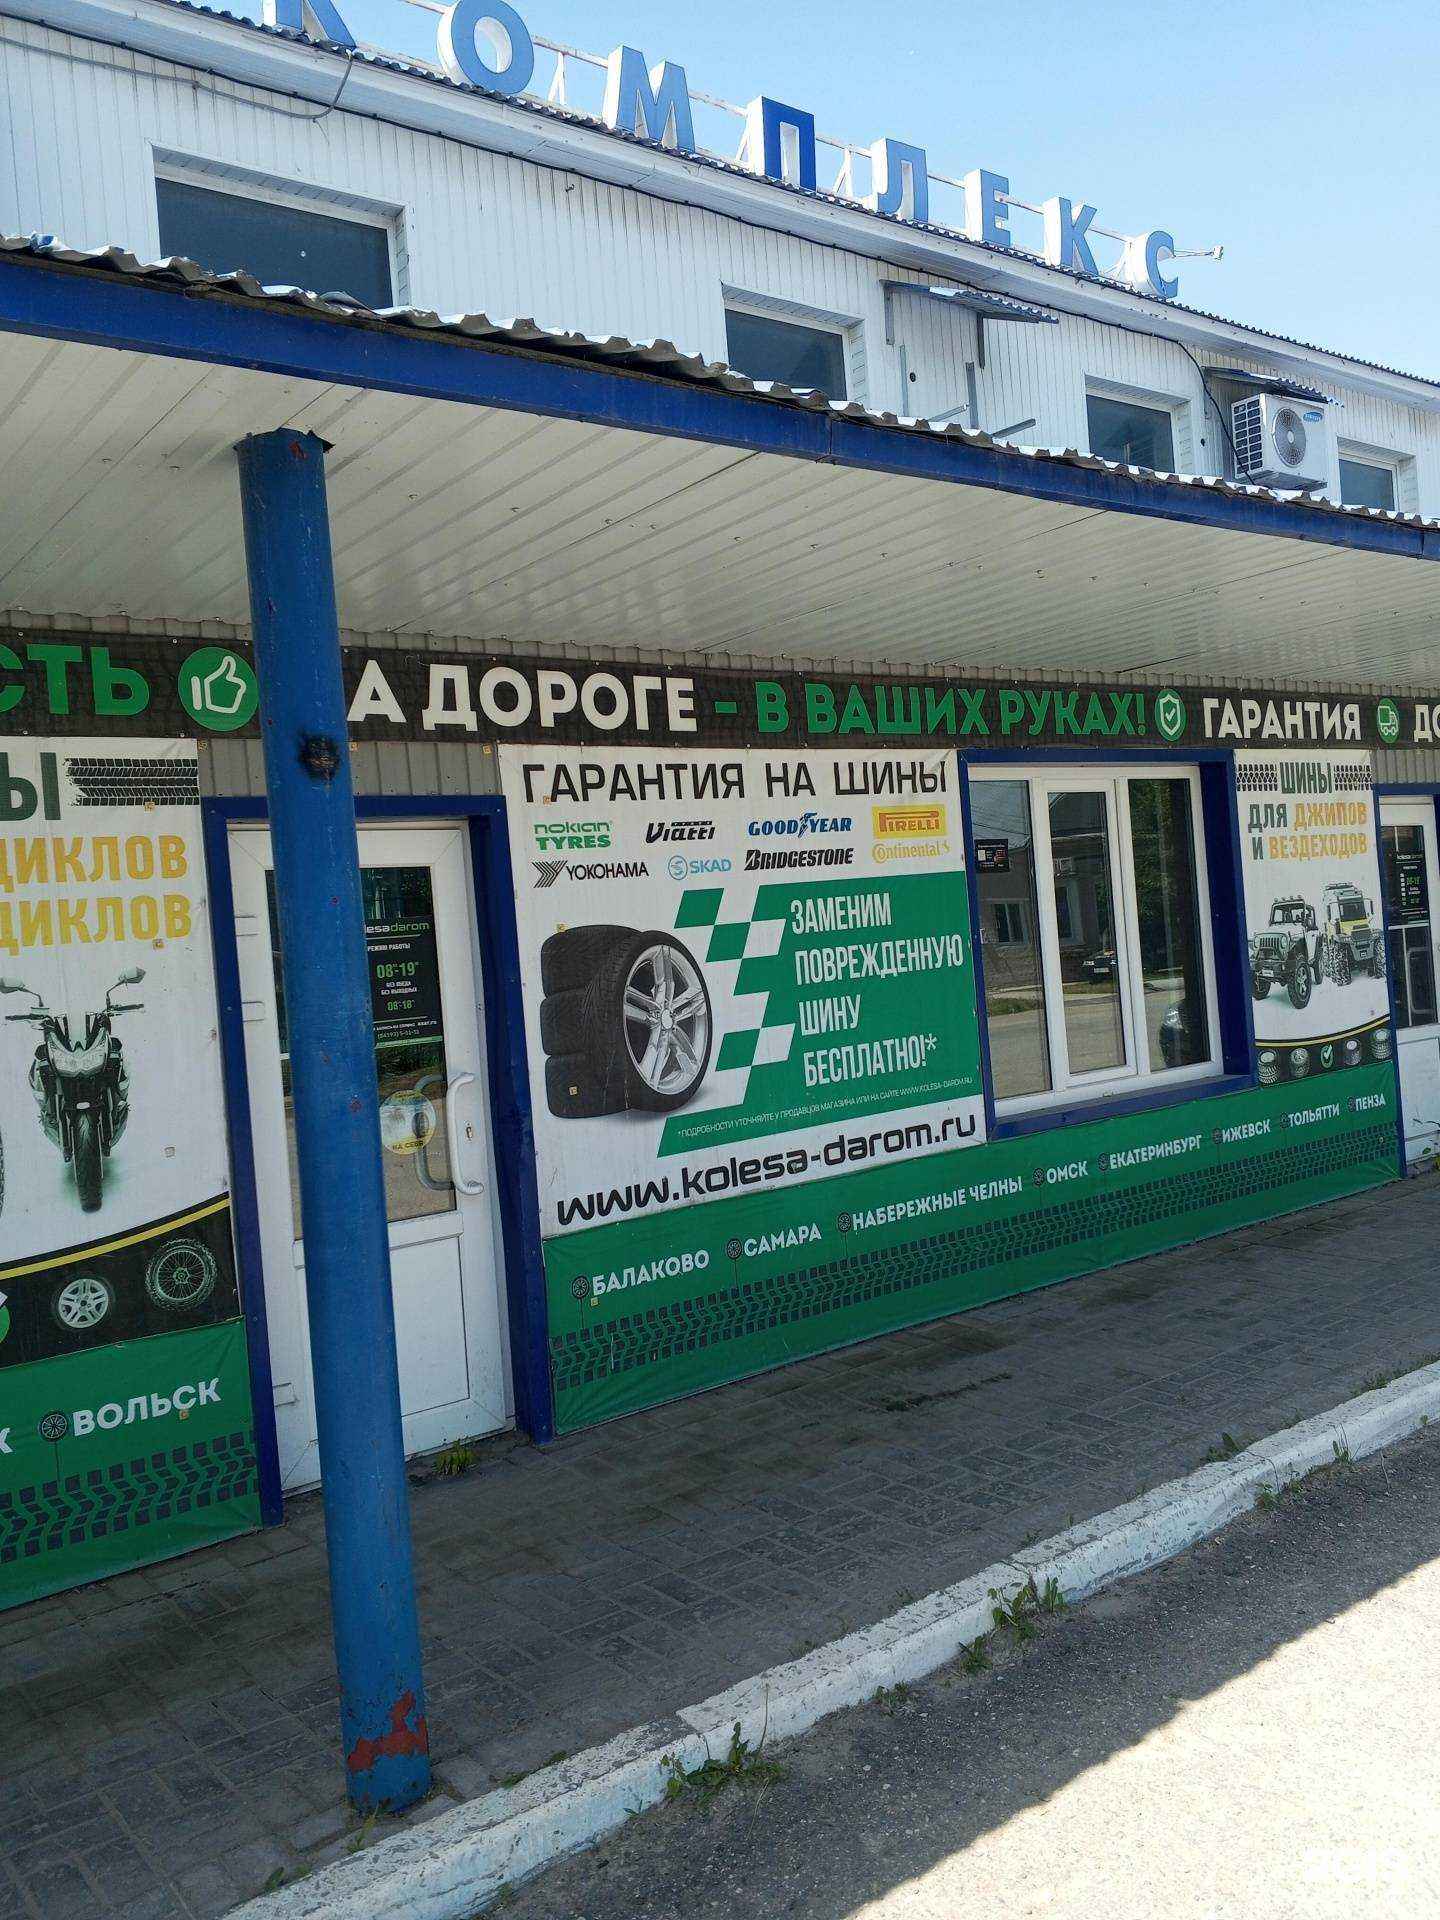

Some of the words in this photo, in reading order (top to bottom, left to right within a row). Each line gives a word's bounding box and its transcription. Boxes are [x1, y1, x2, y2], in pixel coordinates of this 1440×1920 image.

[422, 664, 698, 733] ДОРОГЕ
[755, 681, 790, 734] В
[805, 682, 990, 735] ВАШИХ
[1000, 688, 1146, 736] РУКАХ!
[1202, 698, 1362, 741] ГАРАНТИЯ
[522, 763, 745, 803] ГАРАНТИЯ
[766, 763, 816, 798] НА
[834, 761, 947, 796] ШИНЫ
[1279, 762, 1333, 794] ШИНЫ
[878, 811, 940, 833] PIRELLI
[1248, 803, 1288, 833] ДЛЯ
[1294, 802, 1368, 832] ДЖИПОВ
[536, 835, 611, 851] TYRES
[744, 848, 855, 871] BRIDGESTONE
[1252, 836, 1264, 861] И
[1268, 832, 1368, 862] ВЕЗДЕХОДОВ
[566, 861, 649, 881] YOKOHAMA
[689, 858, 732, 874] SKAD
[790, 892, 892, 935] ЗАМЕНИМ
[795, 934, 964, 985] ПОВРЕЖДЕННУЮ
[799, 994, 861, 1036] ШИНУ
[557, 1114, 977, 1226] www.kolesa-darom.ru
[592, 1249, 710, 1297] БАЛАКОВО
[743, 1222, 822, 1258] САМАРА
[852, 1184, 967, 1232] НАБЕРЕЖНЫЕ
[969, 1175, 1023, 1203] ЧЕЛНЫ
[1046, 1160, 1088, 1185] ОМСК
[1109, 1134, 1203, 1171] ЕКАТЕРИНБУРГ
[1222, 1118, 1271, 1144] ИЖЕВСК
[1287, 1103, 1341, 1128] ТОЛЬЯТТИ
[1354, 1095, 1387, 1113] ПЕНЗА
[72, 1377, 222, 1437] ВОЛЬСК
